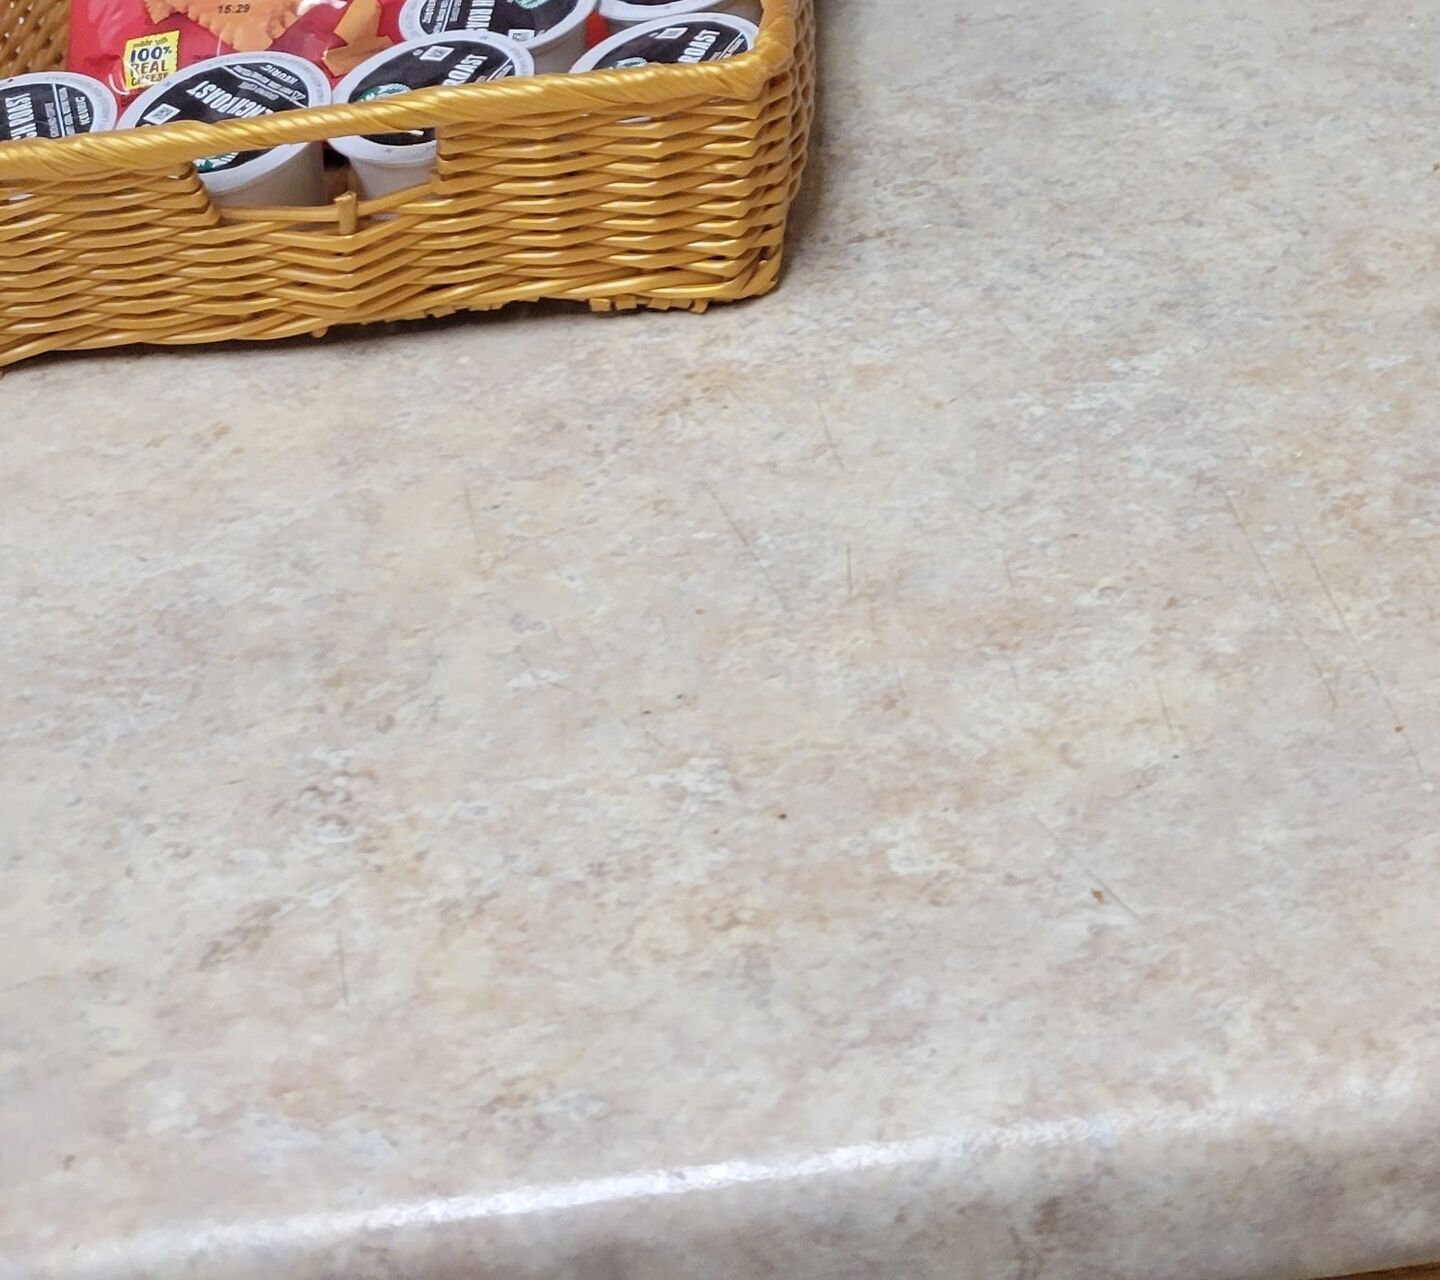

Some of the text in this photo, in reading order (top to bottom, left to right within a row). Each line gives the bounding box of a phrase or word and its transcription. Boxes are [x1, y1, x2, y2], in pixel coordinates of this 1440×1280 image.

[465, 8, 494, 30] ROA
[130, 46, 173, 63] 100%
[5, 92, 35, 128] ROAST
